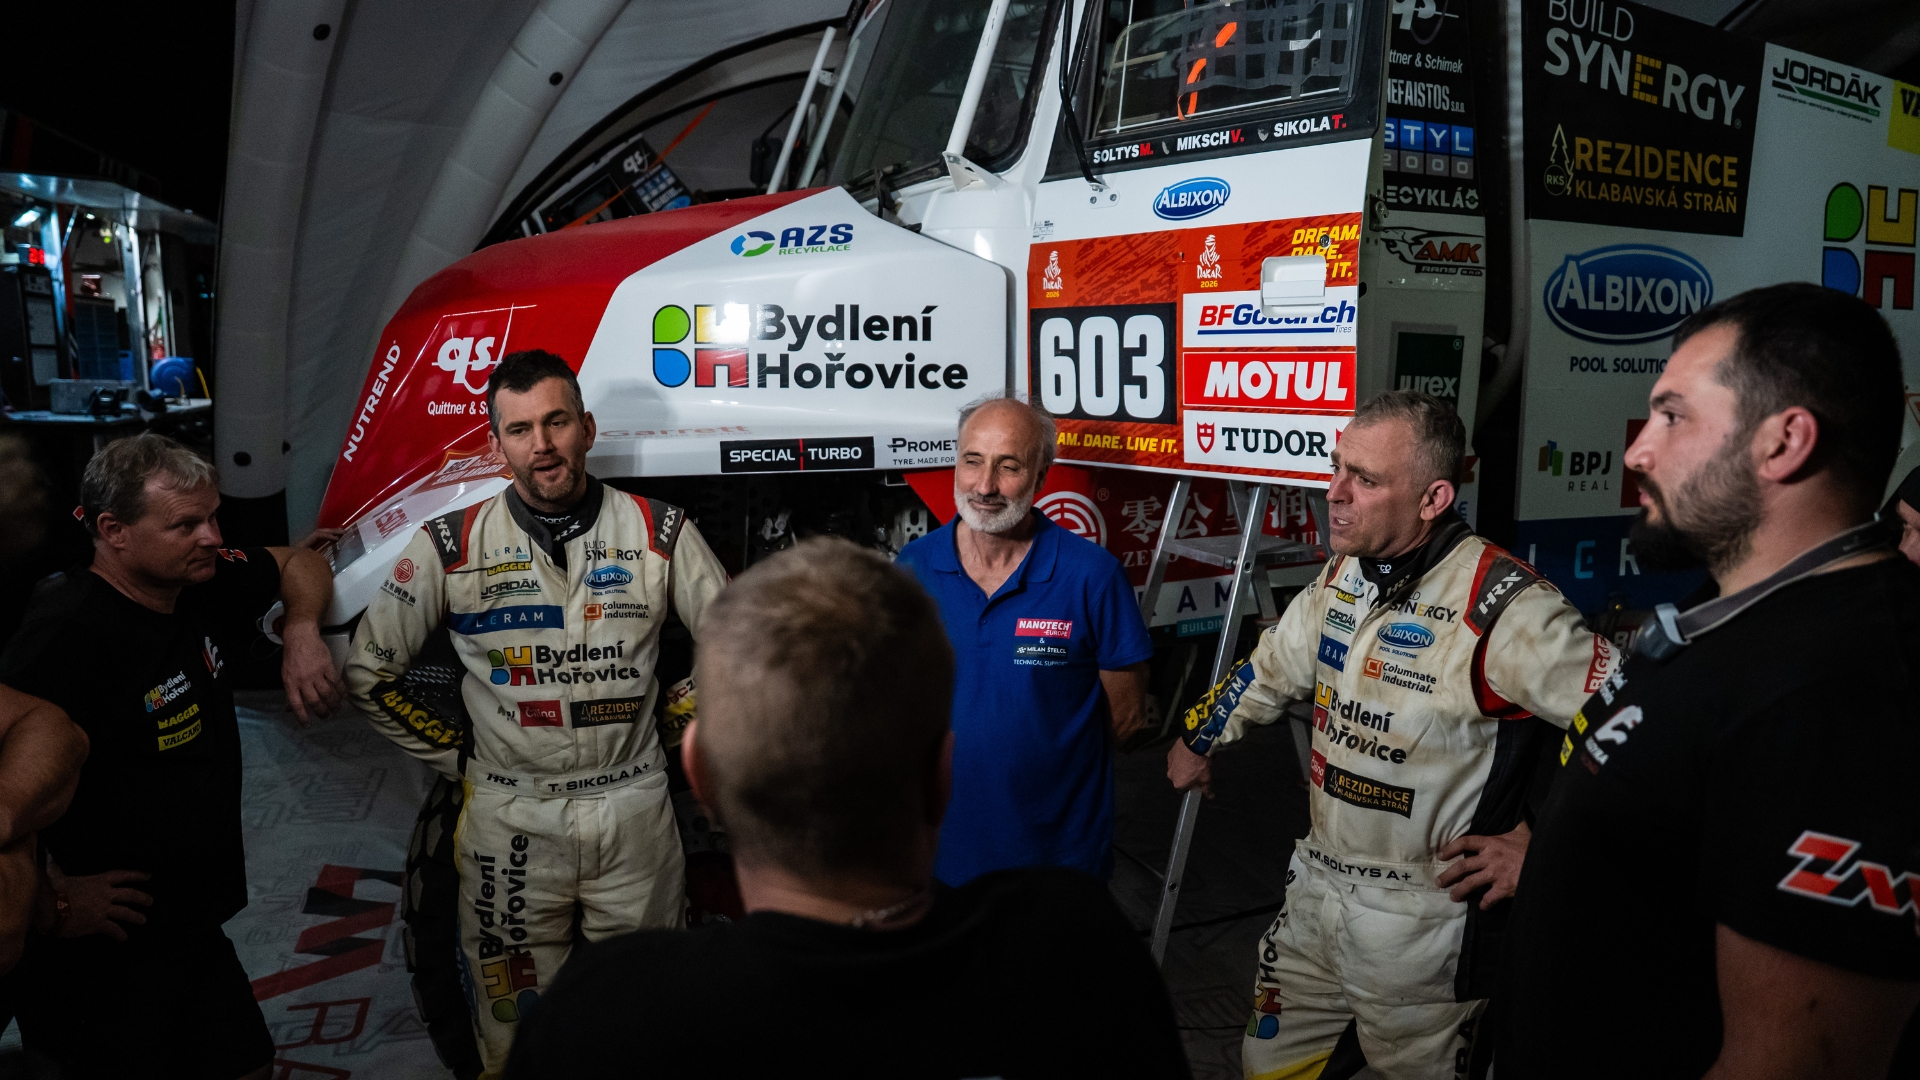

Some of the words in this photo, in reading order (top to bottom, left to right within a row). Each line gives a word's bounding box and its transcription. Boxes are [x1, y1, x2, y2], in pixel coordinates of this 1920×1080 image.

[1549, 0, 1634, 41] BUILD
[1415, 52, 1422, 67] &
[1425, 54, 1463, 73] Schimek
[1273, 116, 1331, 138] SIKOLA
[1331, 114, 1347, 129] T.
[1177, 131, 1230, 152] MIKSCH
[1231, 129, 1245, 144] V.
[1093, 145, 1139, 164] SOLTYS
[1575, 136, 1738, 188] REZIDENCE
[1547, 175, 1564, 186] RKS
[1158, 189, 1225, 209] ALBIXON
[1575, 179, 1678, 208] KLABAVSKÁ
[1683, 190, 1737, 213] STRÁŇ
[779, 224, 853, 248] AZS
[779, 244, 850, 255] RECYKLACE
[1414, 241, 1481, 263] AMK
[1197, 264, 1222, 279] DAKAR
[1557, 260, 1702, 315] ALBIXON
[757, 304, 938, 351] Bydlení
[757, 352, 968, 389] Hořovice
[1040, 314, 1165, 419] 603
[1570, 356, 1607, 372] POOL
[1203, 360, 1348, 401] MOTUL
[343, 344, 400, 462] NUTREND
[428, 401, 466, 416] Quittner
[469, 401, 476, 415] &
[1083, 434, 1123, 450] DARE.
[1126, 436, 1158, 452] LIVE
[1160, 438, 1177, 453] IT.
[1222, 427, 1328, 457] TUDOR
[729, 449, 796, 463] SPECIAL
[808, 446, 862, 461] TURBO
[1569, 451, 1611, 475] BPJ
[1568, 480, 1609, 491] REAL
[660, 507, 677, 543] HRX
[484, 546, 527, 560] LERA
[586, 548, 643, 560] SYNERGY
[588, 573, 630, 582] ALBIXON
[1479, 570, 1524, 615] HRX
[602, 601, 649, 610] Columnate
[604, 611, 648, 619] industrial.
[475, 611, 543, 628] LERAM
[1019, 621, 1069, 630] NANOTECH
[1382, 625, 1431, 647] ALBIXON
[536, 640, 625, 668] Bydlení
[1379, 645, 1391, 653] POOL
[1392, 649, 1418, 659] SOLUTIONS
[159, 670, 186, 694] Bydlení
[538, 663, 640, 684] Hořovice
[1382, 672, 1433, 694] industrial.
[1383, 662, 1437, 685] Columnate
[1201, 676, 1246, 741] LRAM
[487, 774, 519, 786] HRX
[548, 784, 561, 792] T.
[566, 770, 629, 790] SIKOLA
[1339, 774, 1410, 804] REZIDENCE
[474, 850, 503, 960] Bydlení
[501, 835, 532, 957] Hořovice
